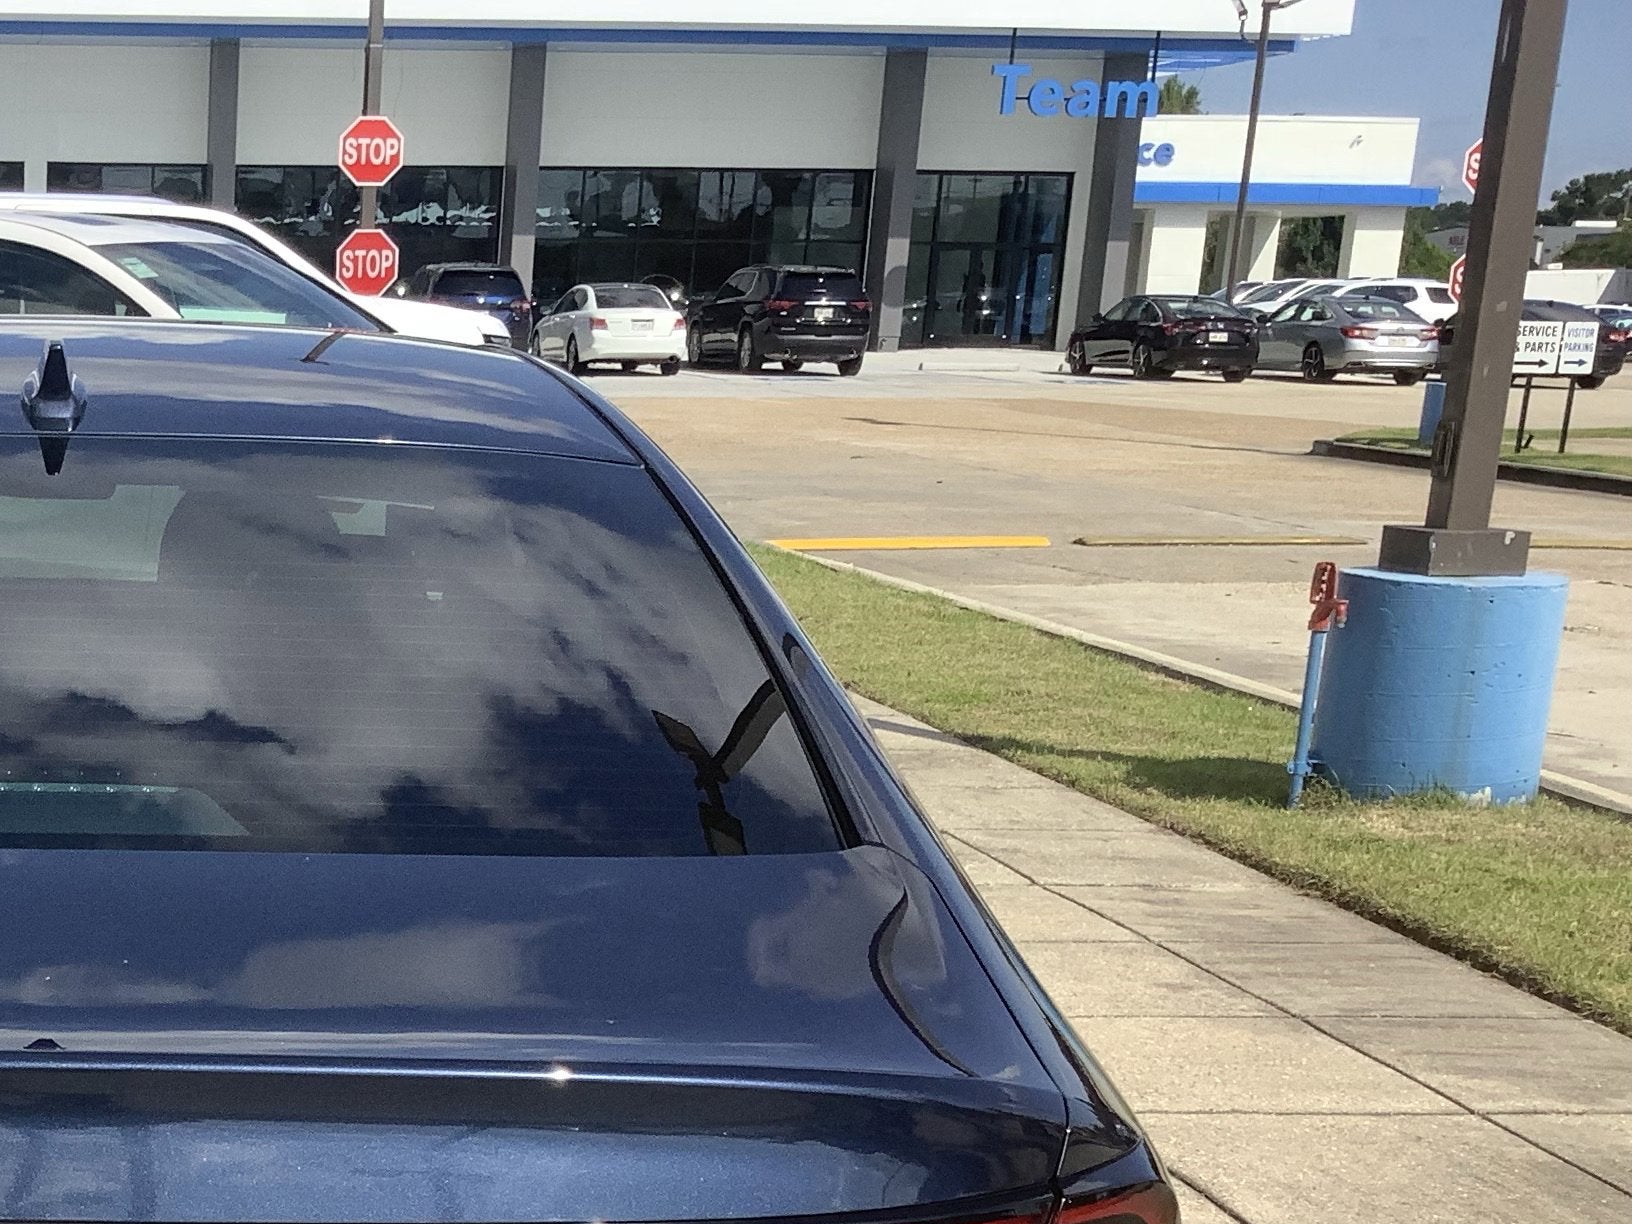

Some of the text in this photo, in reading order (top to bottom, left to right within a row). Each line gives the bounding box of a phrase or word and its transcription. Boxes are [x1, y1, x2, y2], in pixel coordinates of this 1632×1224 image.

[992, 64, 1159, 118] Team
[344, 137, 399, 166] STOP
[341, 249, 393, 279] STOP
[1518, 325, 1558, 337] SERVICE
[1568, 327, 1595, 338] VISITOR
[1524, 341, 1556, 353] PARTS
[1564, 342, 1594, 353] PARKING
